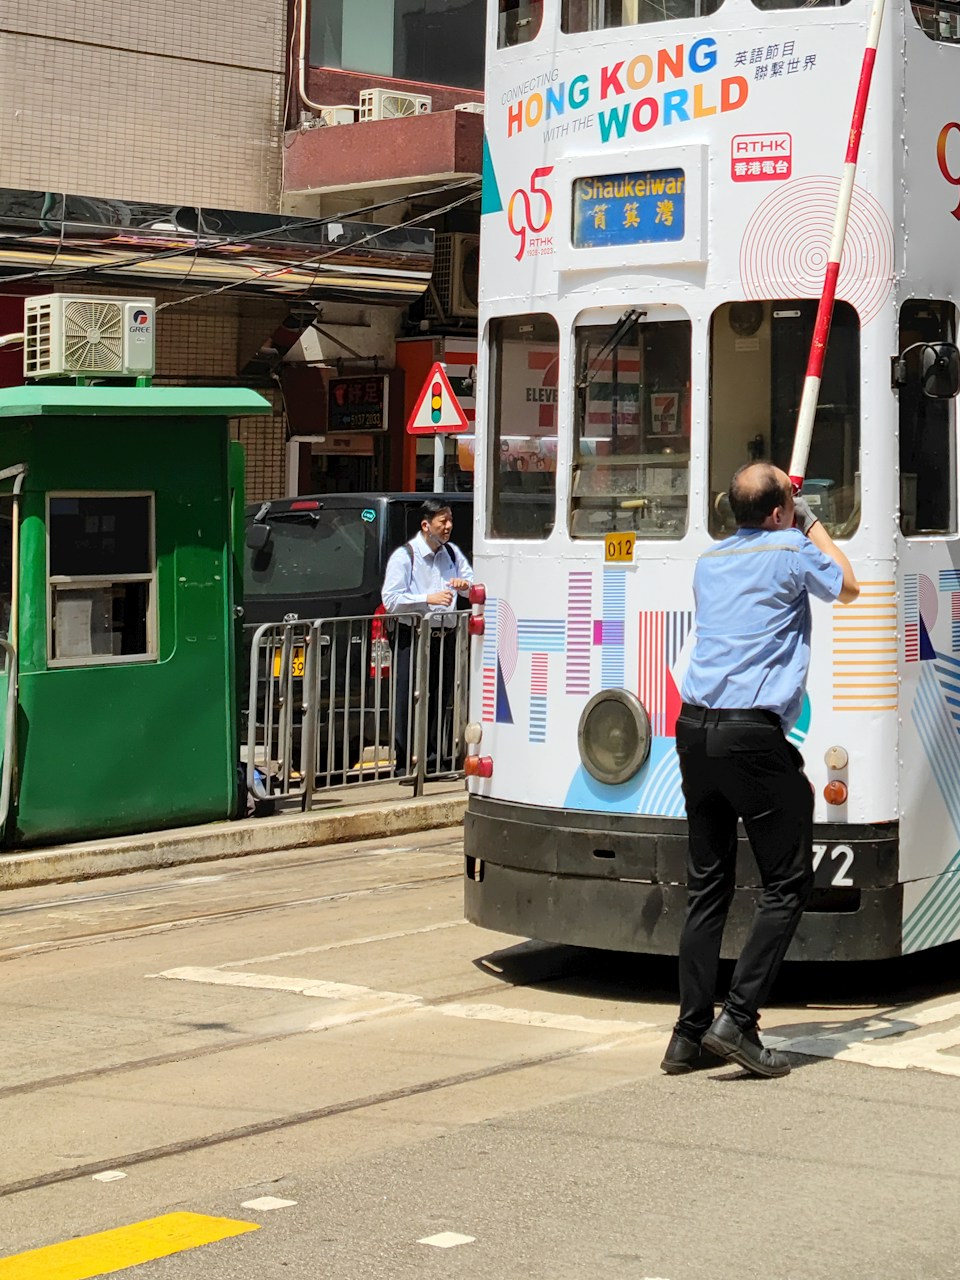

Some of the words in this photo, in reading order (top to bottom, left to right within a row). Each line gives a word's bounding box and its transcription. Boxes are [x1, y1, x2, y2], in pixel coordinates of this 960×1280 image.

[734, 40, 796, 68] 英語節目
[753, 54, 818, 81] 聯繫世界
[501, 68, 559, 106] CONNECTING
[507, 74, 590, 138] HONG
[600, 37, 718, 101] KONG
[543, 120, 570, 143] WITH
[572, 114, 595, 135] THE
[598, 75, 749, 144] WORLD
[736, 137, 786, 153] RTHK
[734, 160, 789, 177] 香港電台
[507, 165, 554, 262] 95
[592, 200, 674, 230] 筲箕灣
[526, 247, 554, 257] 1928-2023
[529, 237, 553, 248] RTHK
[128, 325, 151, 334] GREE
[607, 541, 633, 560] 012
